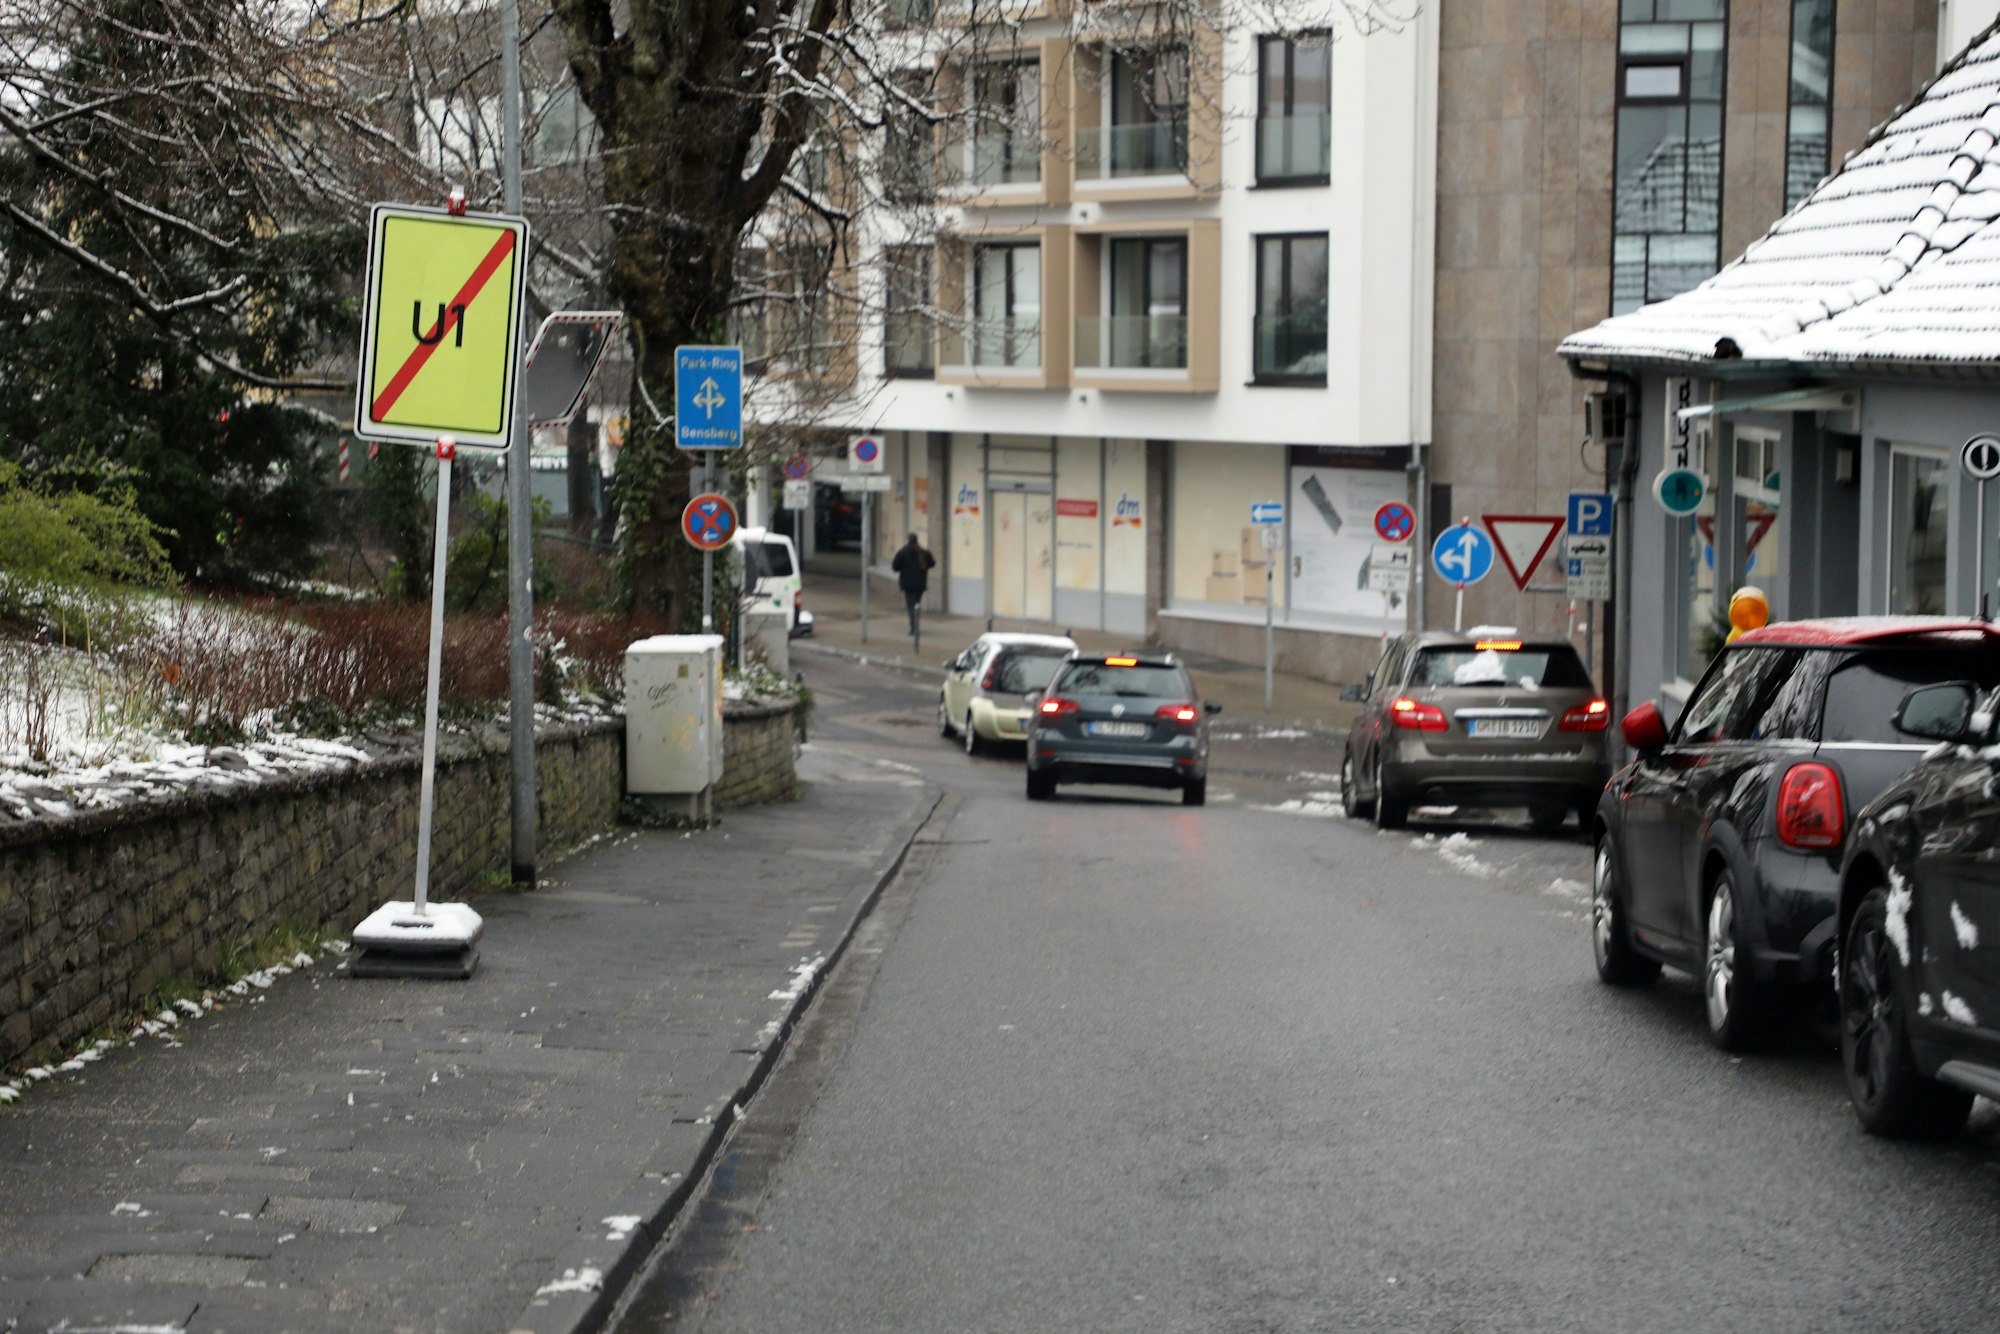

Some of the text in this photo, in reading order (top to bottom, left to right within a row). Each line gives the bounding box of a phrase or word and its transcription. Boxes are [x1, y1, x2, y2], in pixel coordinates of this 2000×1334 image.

[412, 299, 465, 349] U1
[681, 356, 737, 373] Park-Ring
[681, 425, 737, 442] Bensberg
[957, 482, 978, 504] dm
[1117, 492, 1140, 516] dm
[1578, 499, 1602, 534] P
